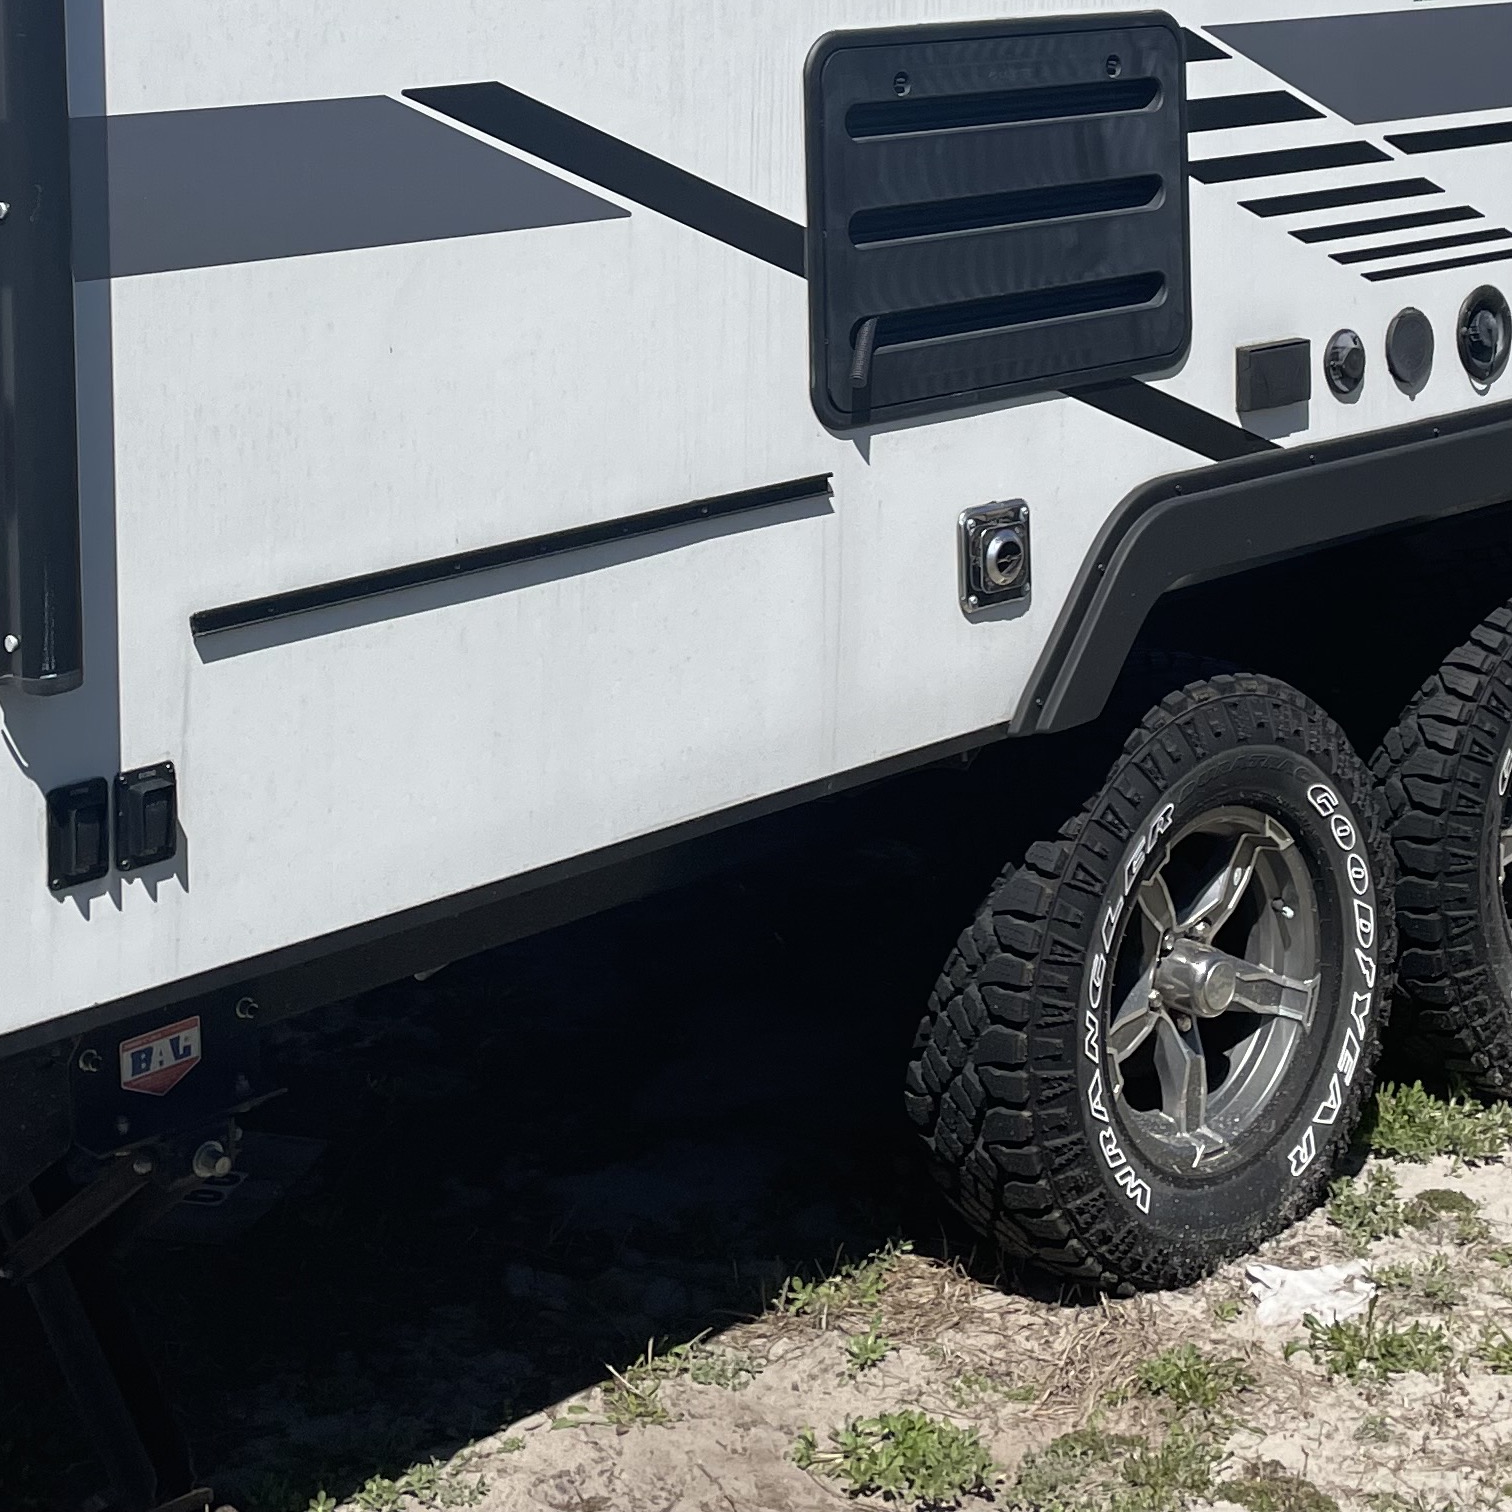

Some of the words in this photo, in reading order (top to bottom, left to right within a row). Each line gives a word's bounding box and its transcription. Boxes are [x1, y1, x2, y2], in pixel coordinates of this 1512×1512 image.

[131, 1034, 192, 1077] BAL
[1084, 803, 1174, 1214] WRANGLER
[1289, 784, 1375, 1177] GOODYEAR
